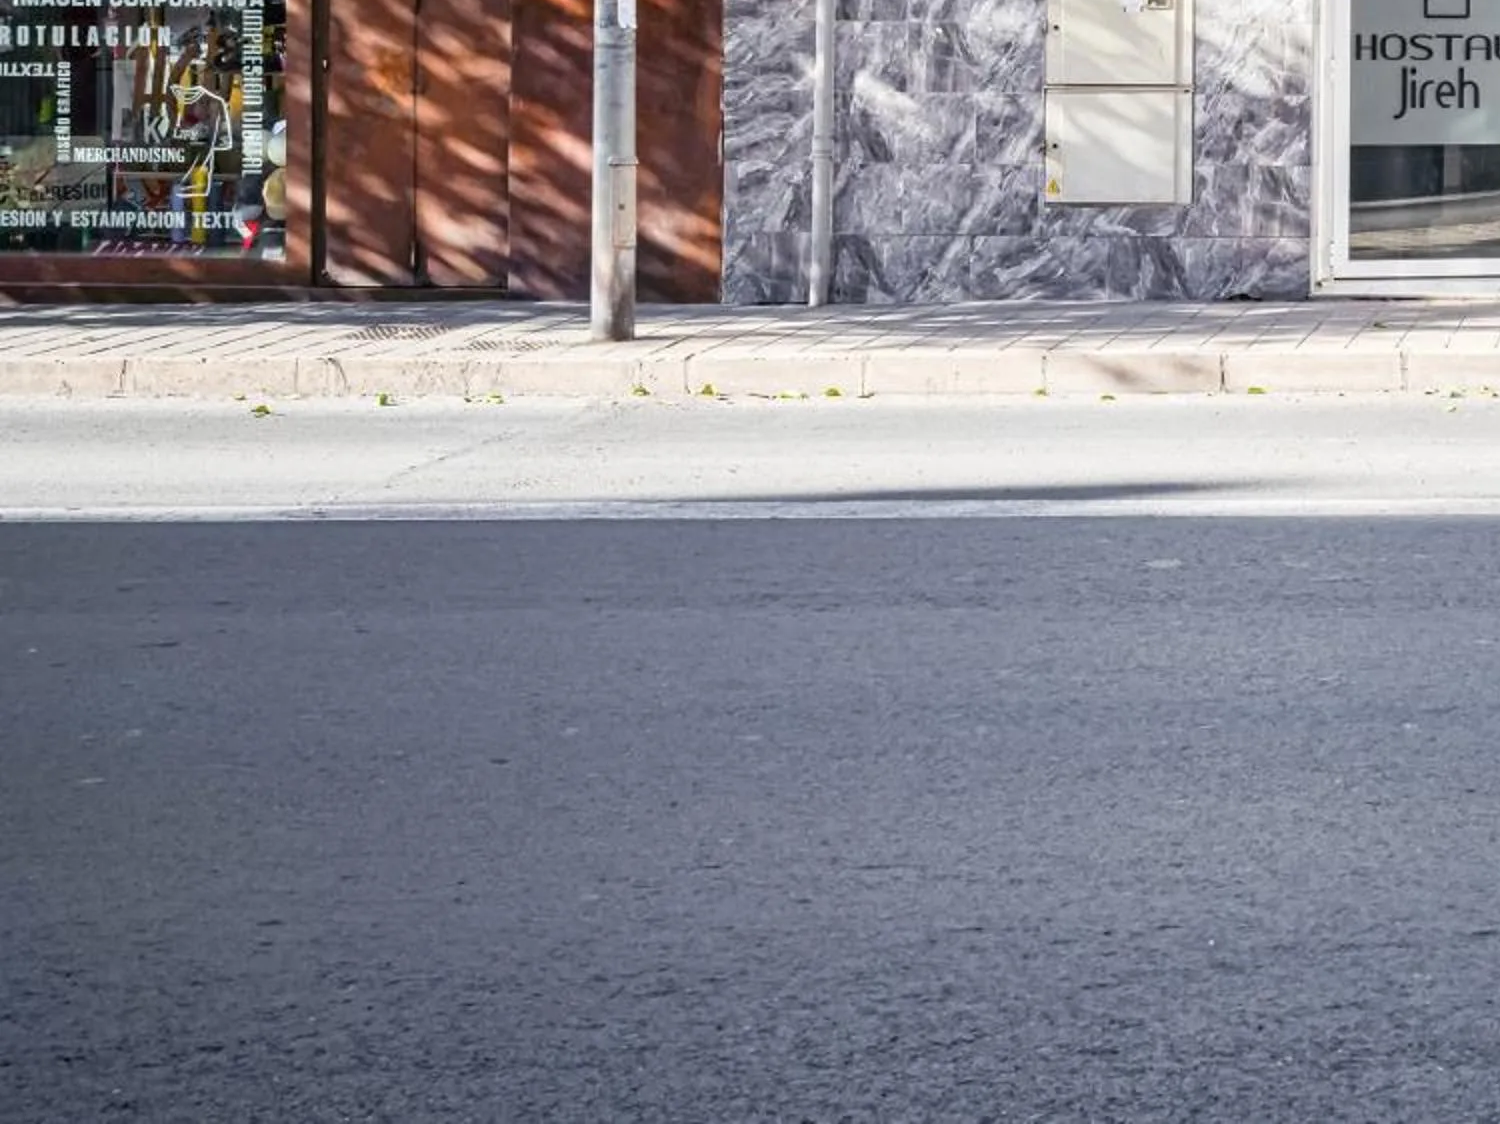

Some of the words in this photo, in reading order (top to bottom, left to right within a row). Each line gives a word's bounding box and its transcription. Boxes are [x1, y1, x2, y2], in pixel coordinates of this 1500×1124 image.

[0, 22, 171, 47] ROTULACIÓN
[1393, 67, 1480, 119] Jireh
[73, 147, 186, 163] MERCHANDISING
[53, 211, 63, 227] Y
[71, 211, 185, 227] ESTAMPACION
